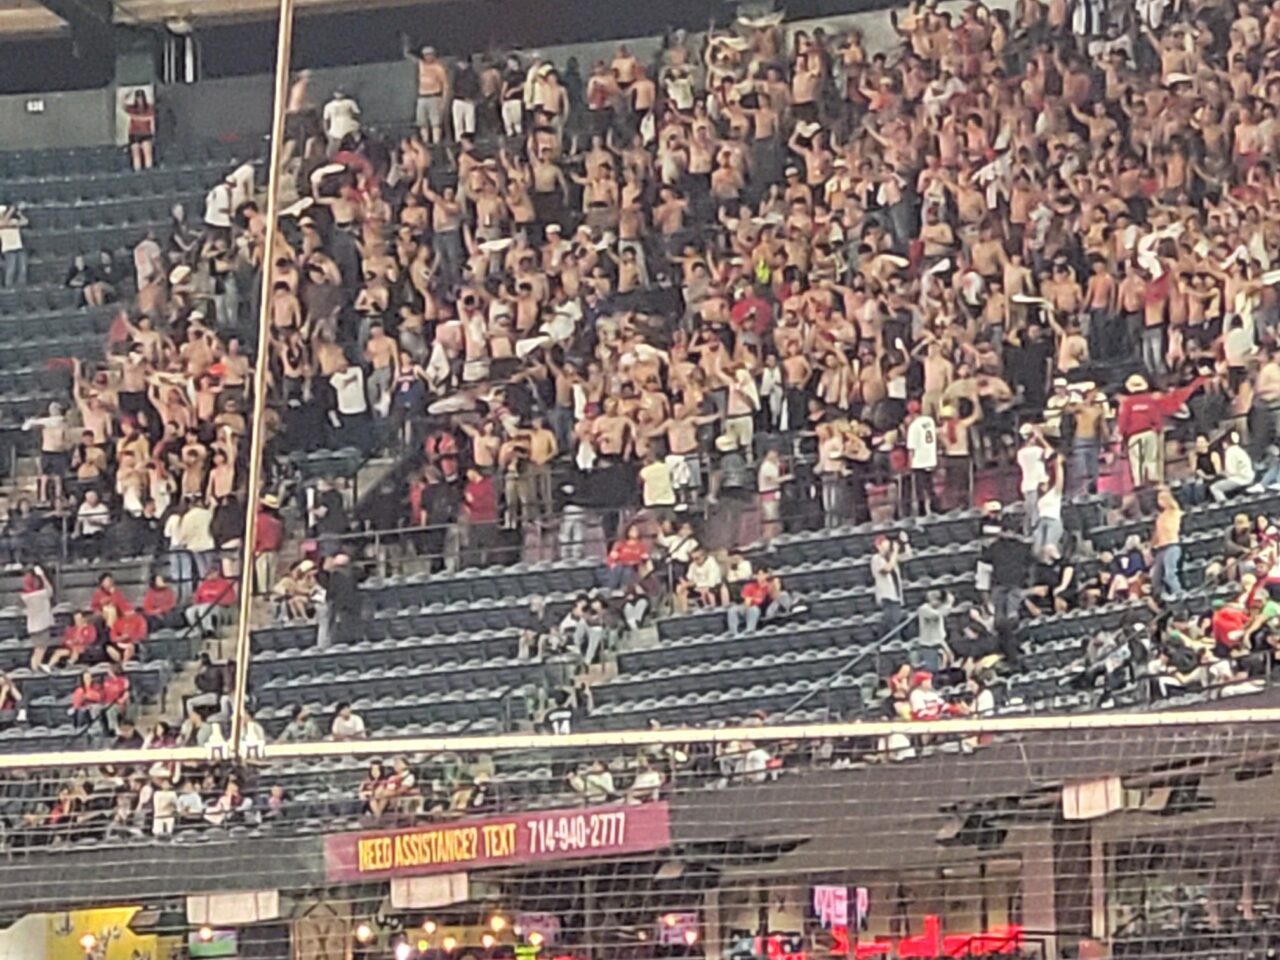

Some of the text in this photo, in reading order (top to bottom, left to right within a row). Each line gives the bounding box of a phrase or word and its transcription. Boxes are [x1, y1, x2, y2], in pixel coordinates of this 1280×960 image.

[358, 837, 392, 872] NEED
[394, 827, 478, 868] ASSISTANCE?
[482, 823, 517, 858] TEXT
